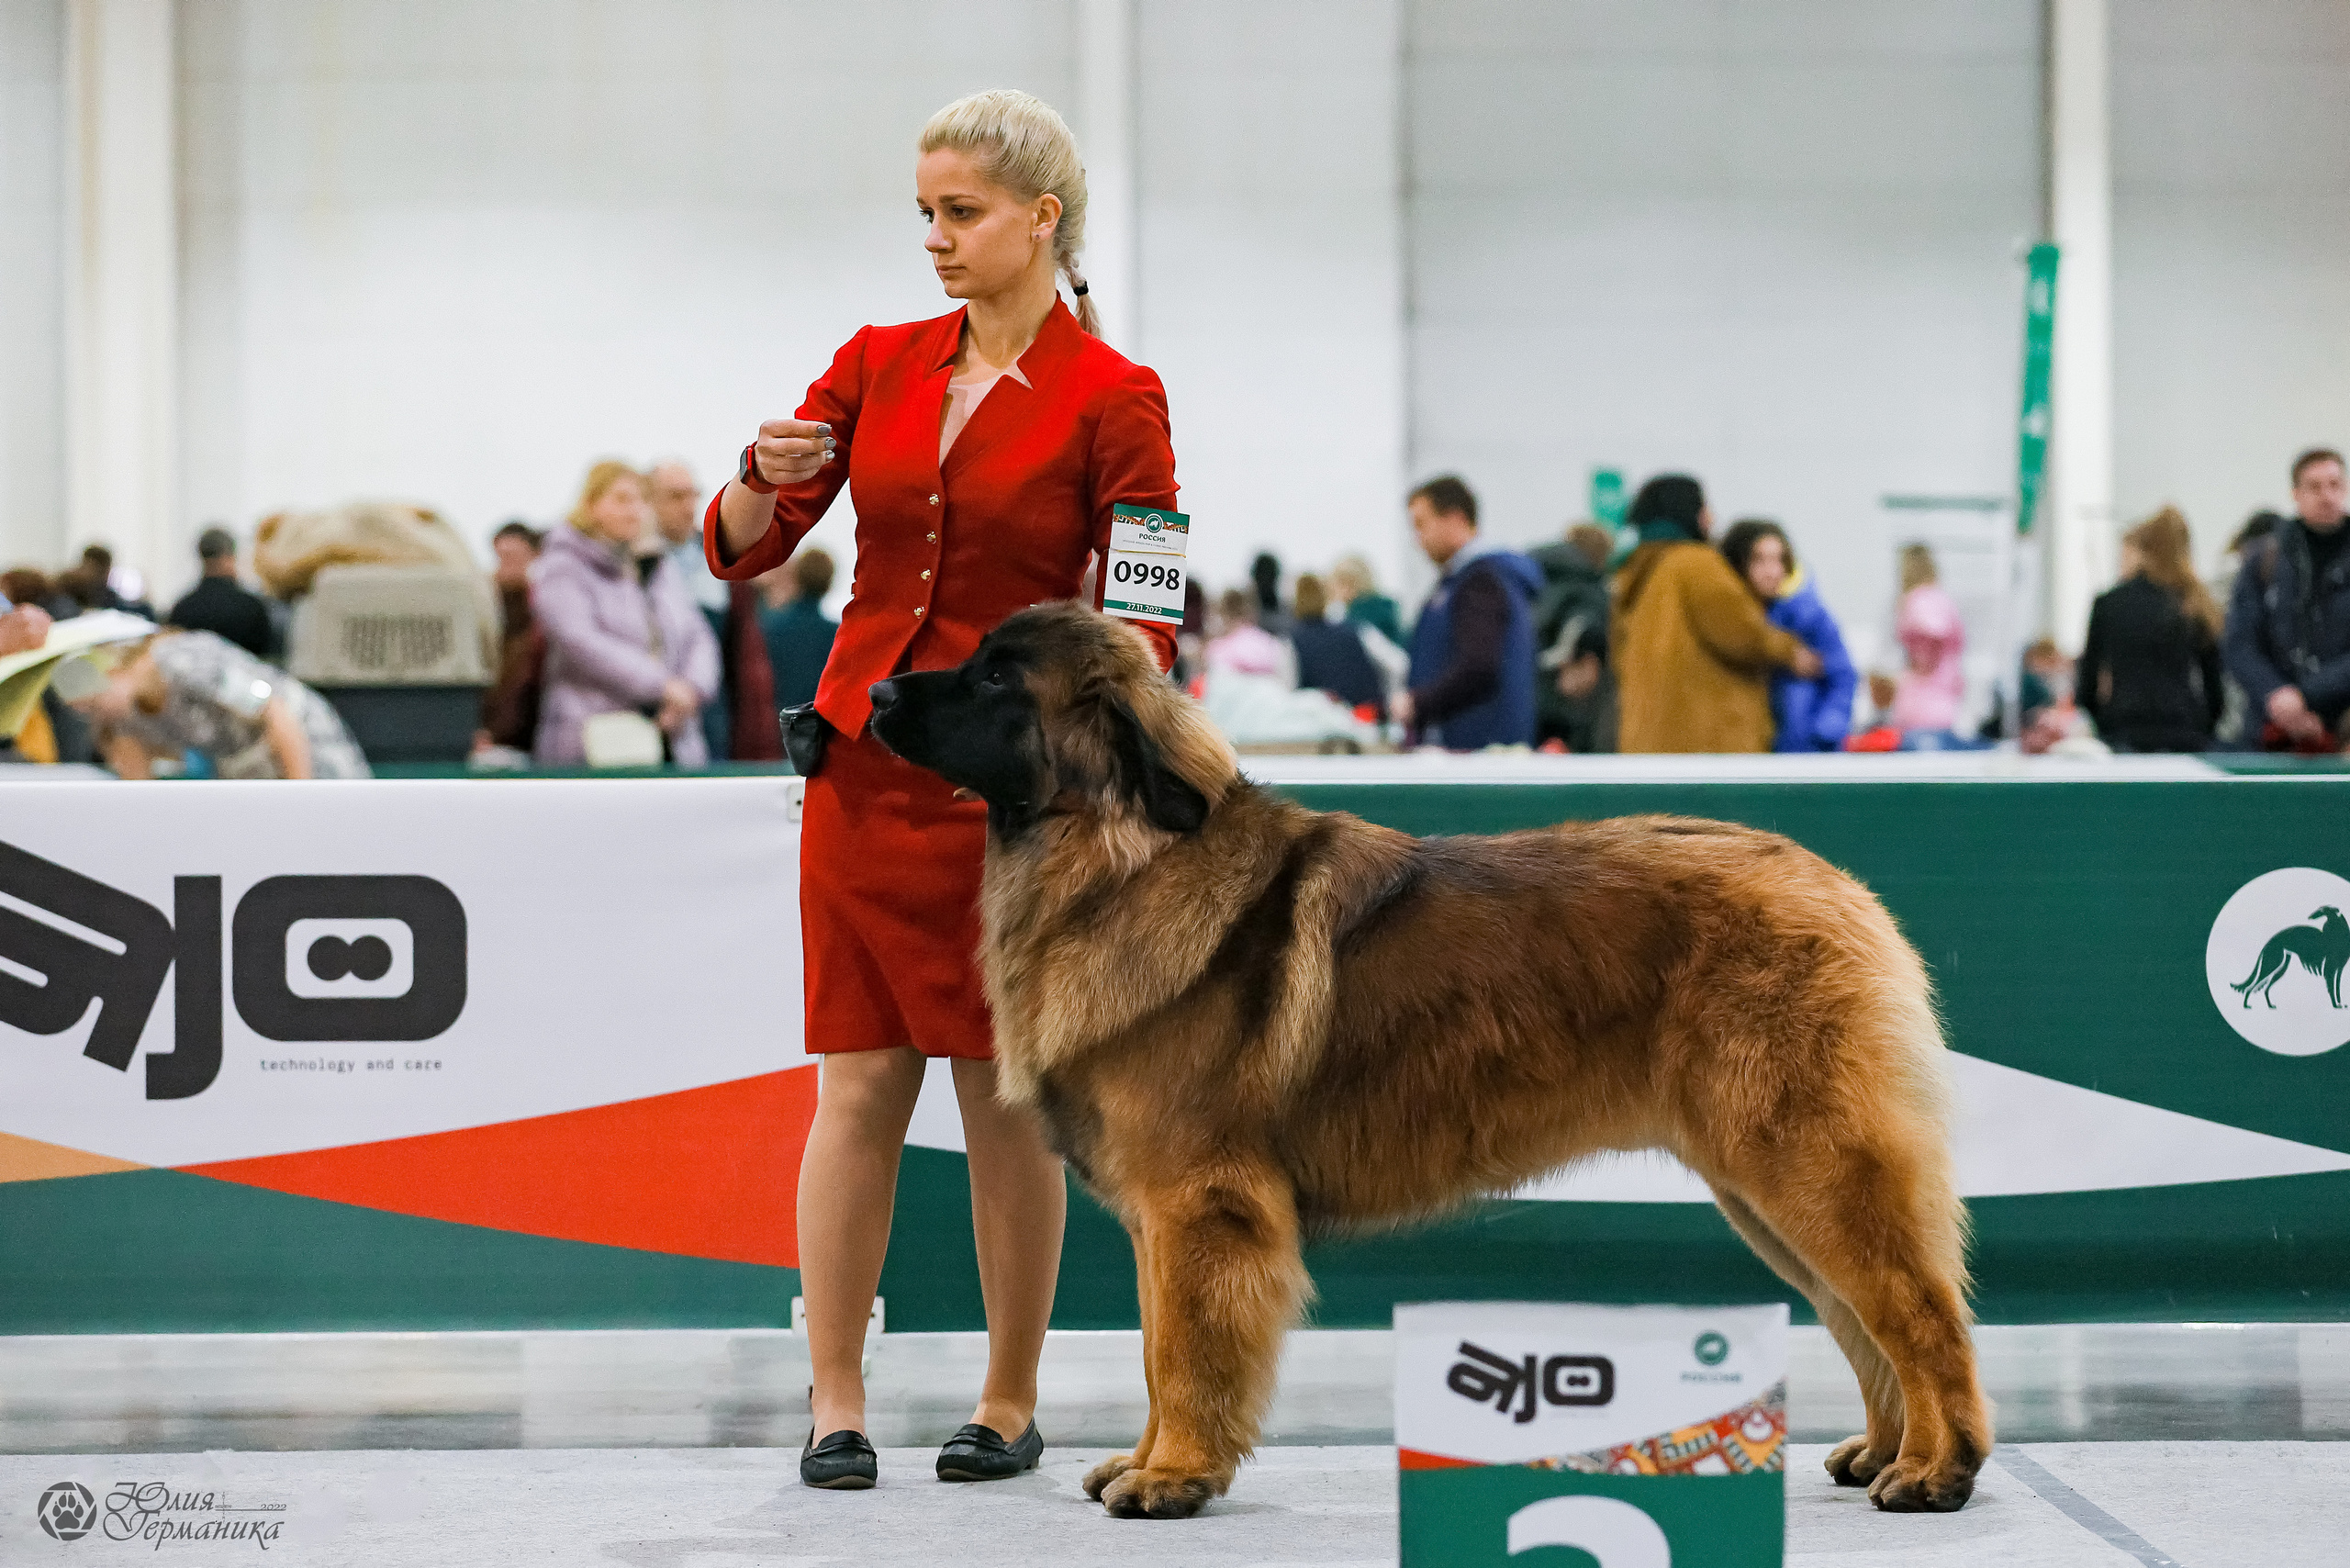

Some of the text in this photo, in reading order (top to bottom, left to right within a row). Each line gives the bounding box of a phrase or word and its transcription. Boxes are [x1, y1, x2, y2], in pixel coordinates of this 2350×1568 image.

[1138, 532, 1166, 543] РОССИЯ
[1113, 560, 1180, 590] 0998
[1125, 602, 1162, 614] 27.11.2022
[260, 1058, 442, 1073] technology and care
